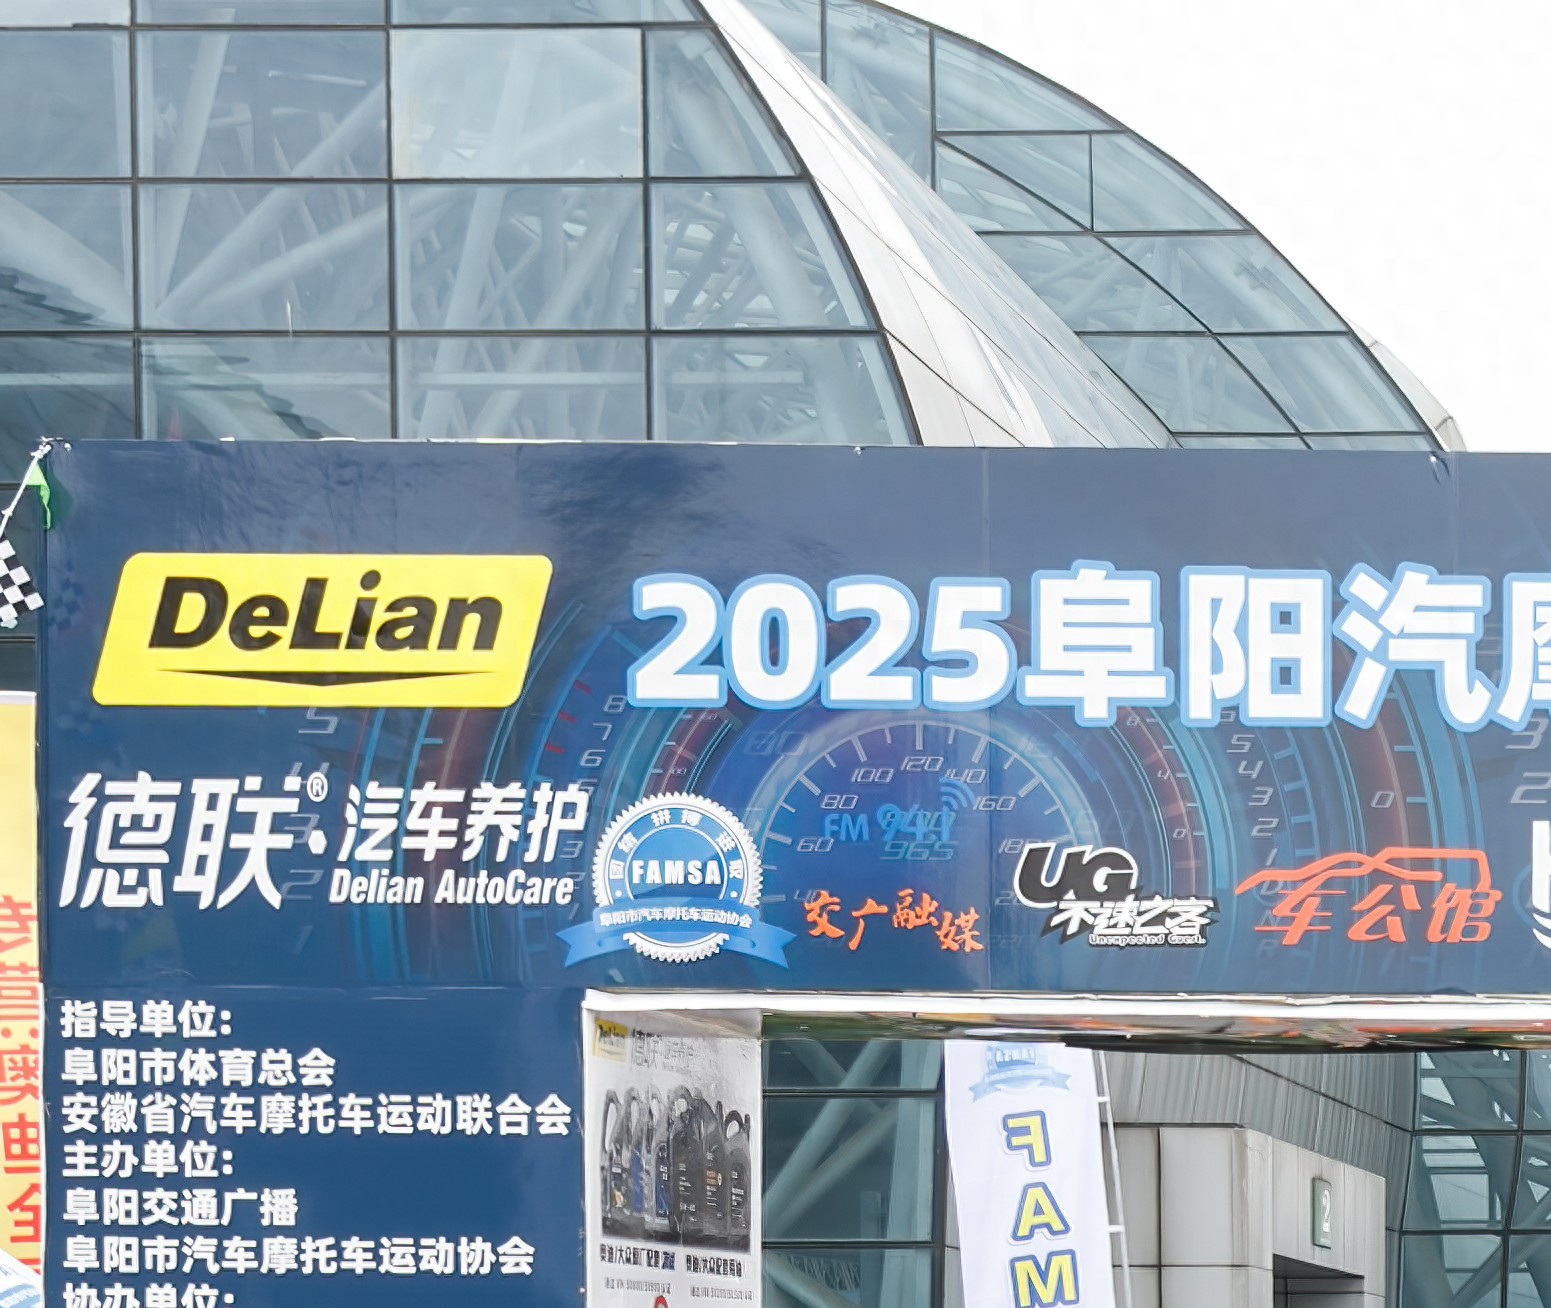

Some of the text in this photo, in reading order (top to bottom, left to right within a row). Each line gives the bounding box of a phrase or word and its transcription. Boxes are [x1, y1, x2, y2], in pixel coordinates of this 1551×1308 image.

[148, 568, 504, 652] DeLian
[338, 780, 589, 863] 汽车养护
[825, 815, 870, 842] FM
[329, 869, 574, 905] Delian AutoCare
[632, 859, 722, 885] FAMSA
[1254, 883, 1503, 945] 车公馆
[61, 1046, 338, 1088] 阜阳市体育总会
[61, 1093, 573, 1137] 安徽省汽车摩托车运动联合会
[62, 1187, 300, 1228] 阜阳交通广播
[63, 1235, 537, 1276] 阜阳市汽车摩托车运动协会
